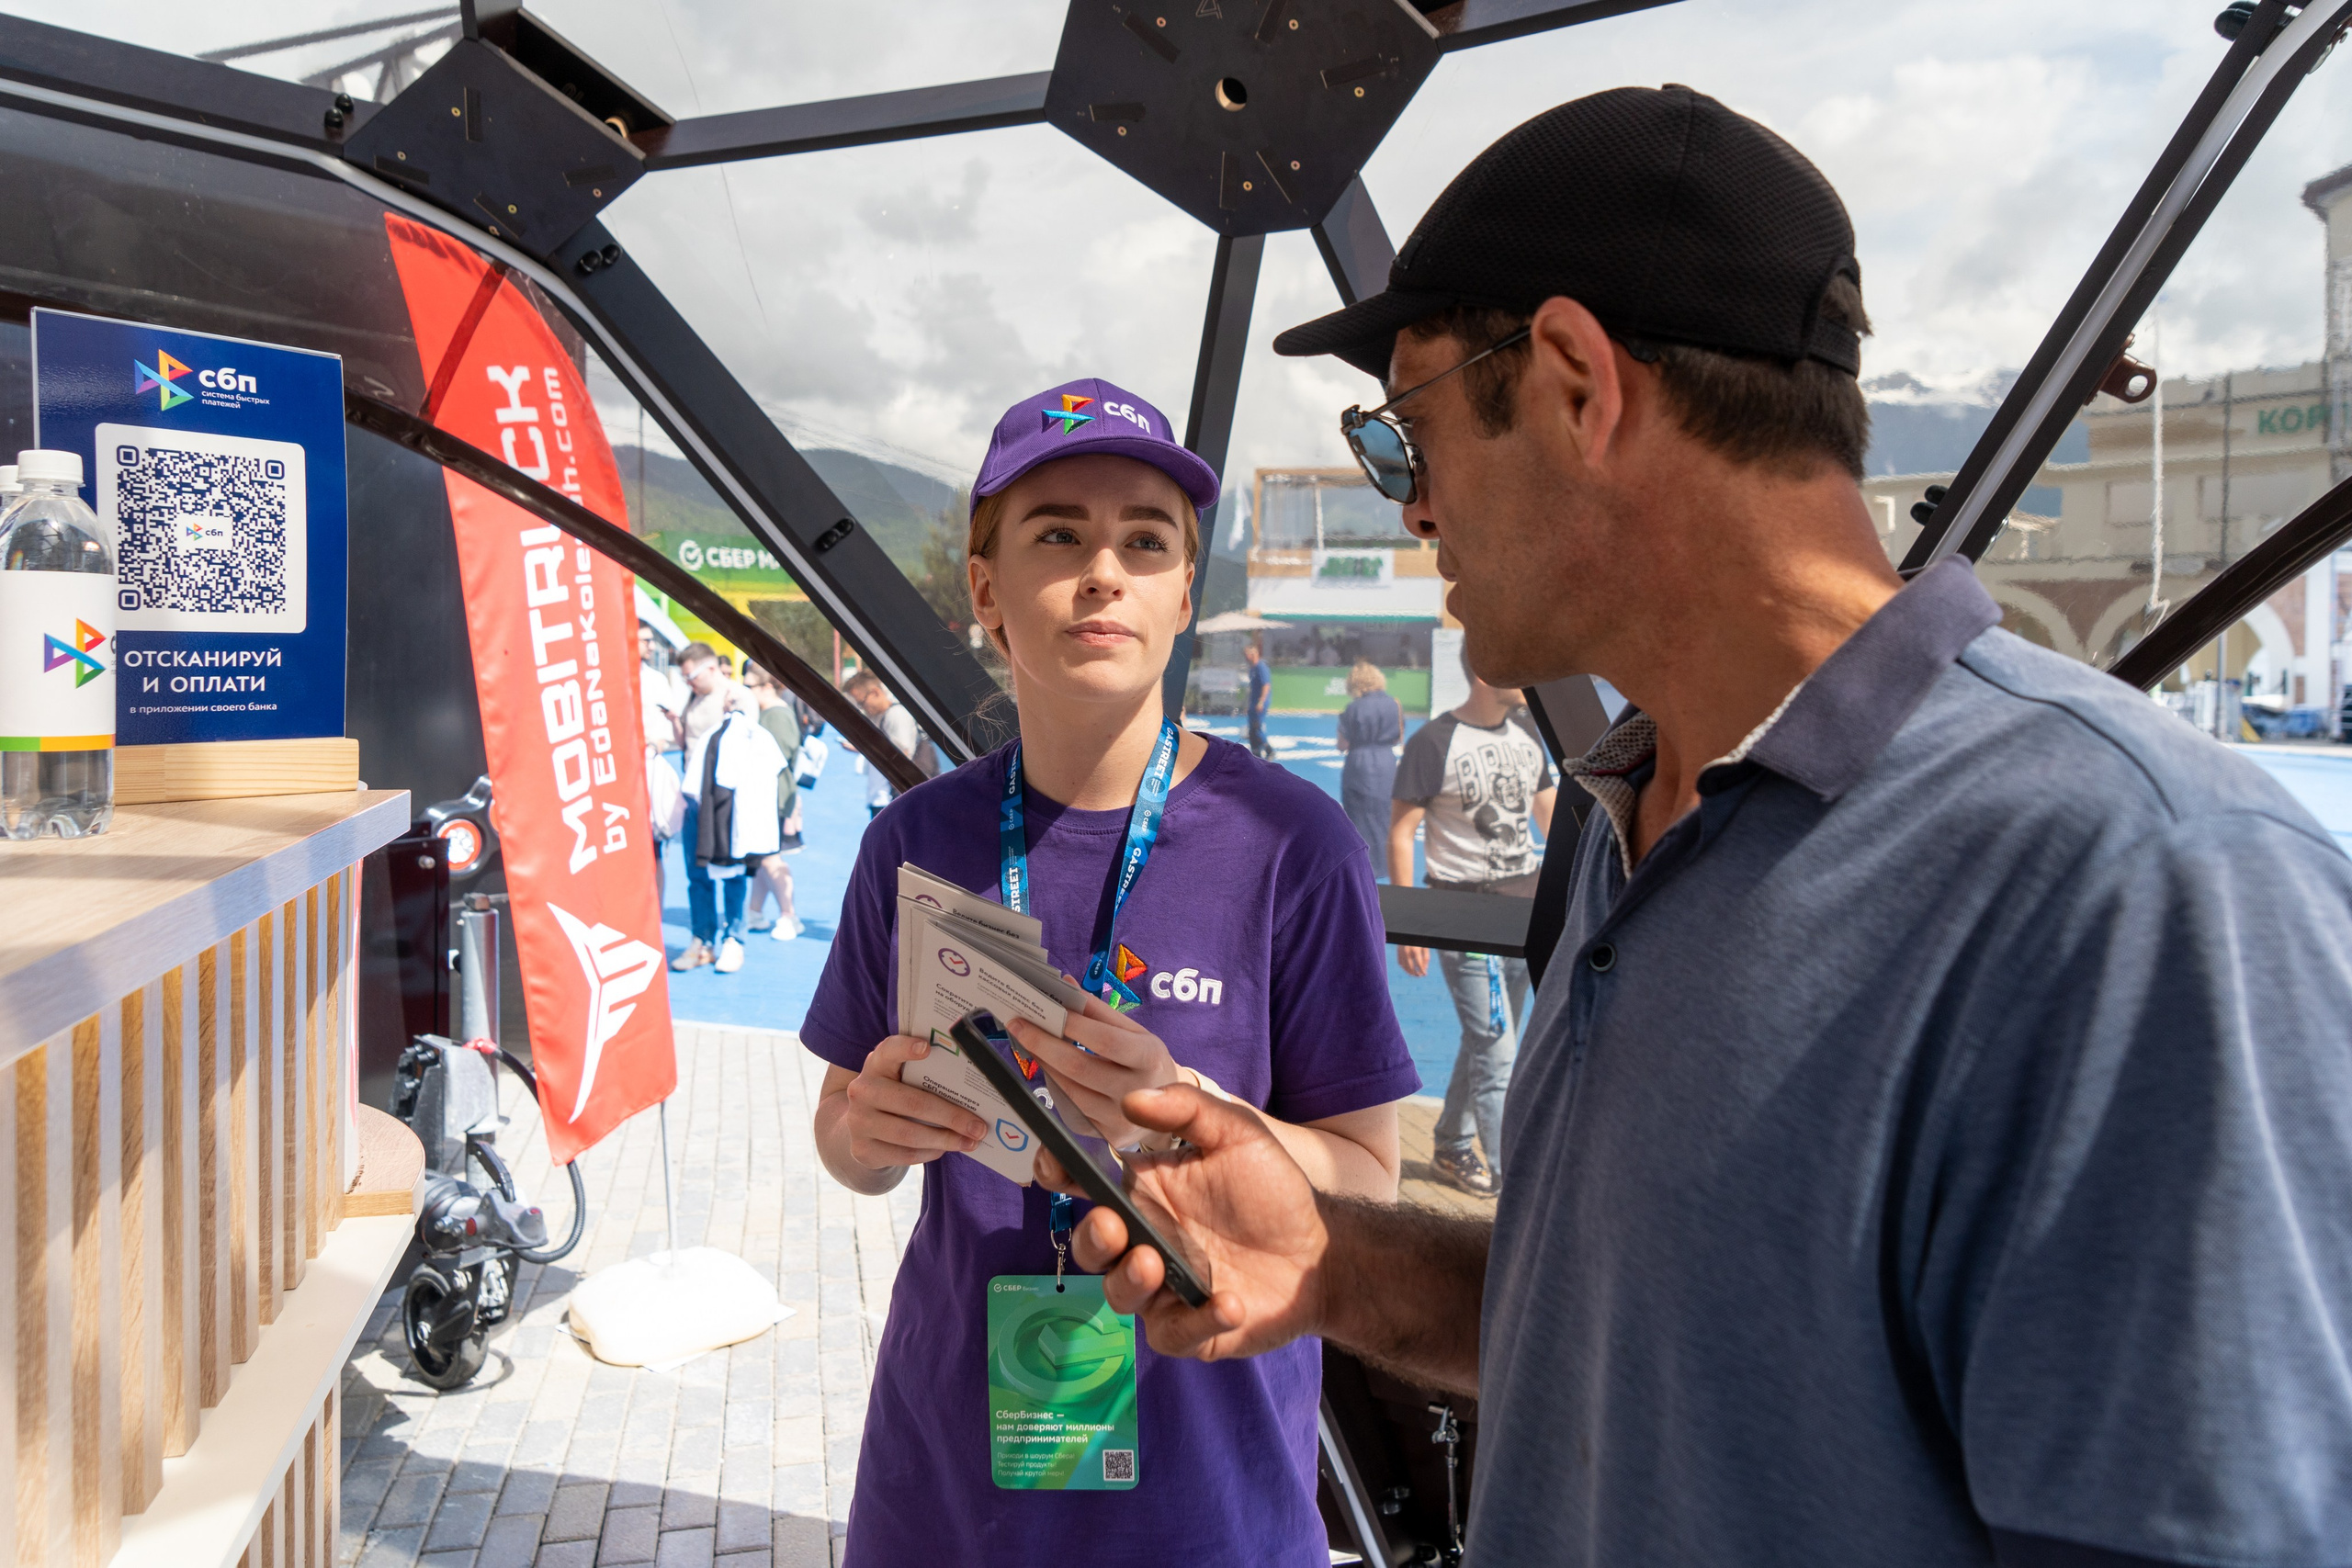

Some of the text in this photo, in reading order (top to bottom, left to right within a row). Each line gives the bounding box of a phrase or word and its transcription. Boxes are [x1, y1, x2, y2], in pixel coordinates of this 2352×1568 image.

[198, 367, 257, 393] сбп
[201, 390, 270, 405] система быстрых
[201, 398, 241, 409] платежей
[1103, 401, 1151, 435] сбп
[205, 528, 223, 537] сбп
[706, 547, 756, 569] СБЕР
[544, 367, 630, 854] by EdaNaKoleh.com
[124, 648, 282, 667] ОТСКАНИРУЙ
[142, 675, 266, 694] И ОПЛАТИ
[139, 704, 209, 716] приложении
[210, 704, 246, 713] своего
[247, 702, 277, 712] банка
[1154, 726, 1174, 781] GASTREET
[936, 983, 974, 1007] Сократите
[1151, 967, 1223, 1005] сбп
[922, 1075, 959, 1097] Операции
[959, 1093, 980, 1107] через
[938, 1089, 978, 1111] полностью
[996, 1410, 1054, 1421] СберБизнес
[1016, 1424, 1063, 1433] доверяют
[997, 1433, 1088, 1444] предпринимателей
[998, 1461, 1025, 1469] Тестируй
[998, 1470, 1024, 1478] Получай
[1024, 1470, 1046, 1478] крутой
